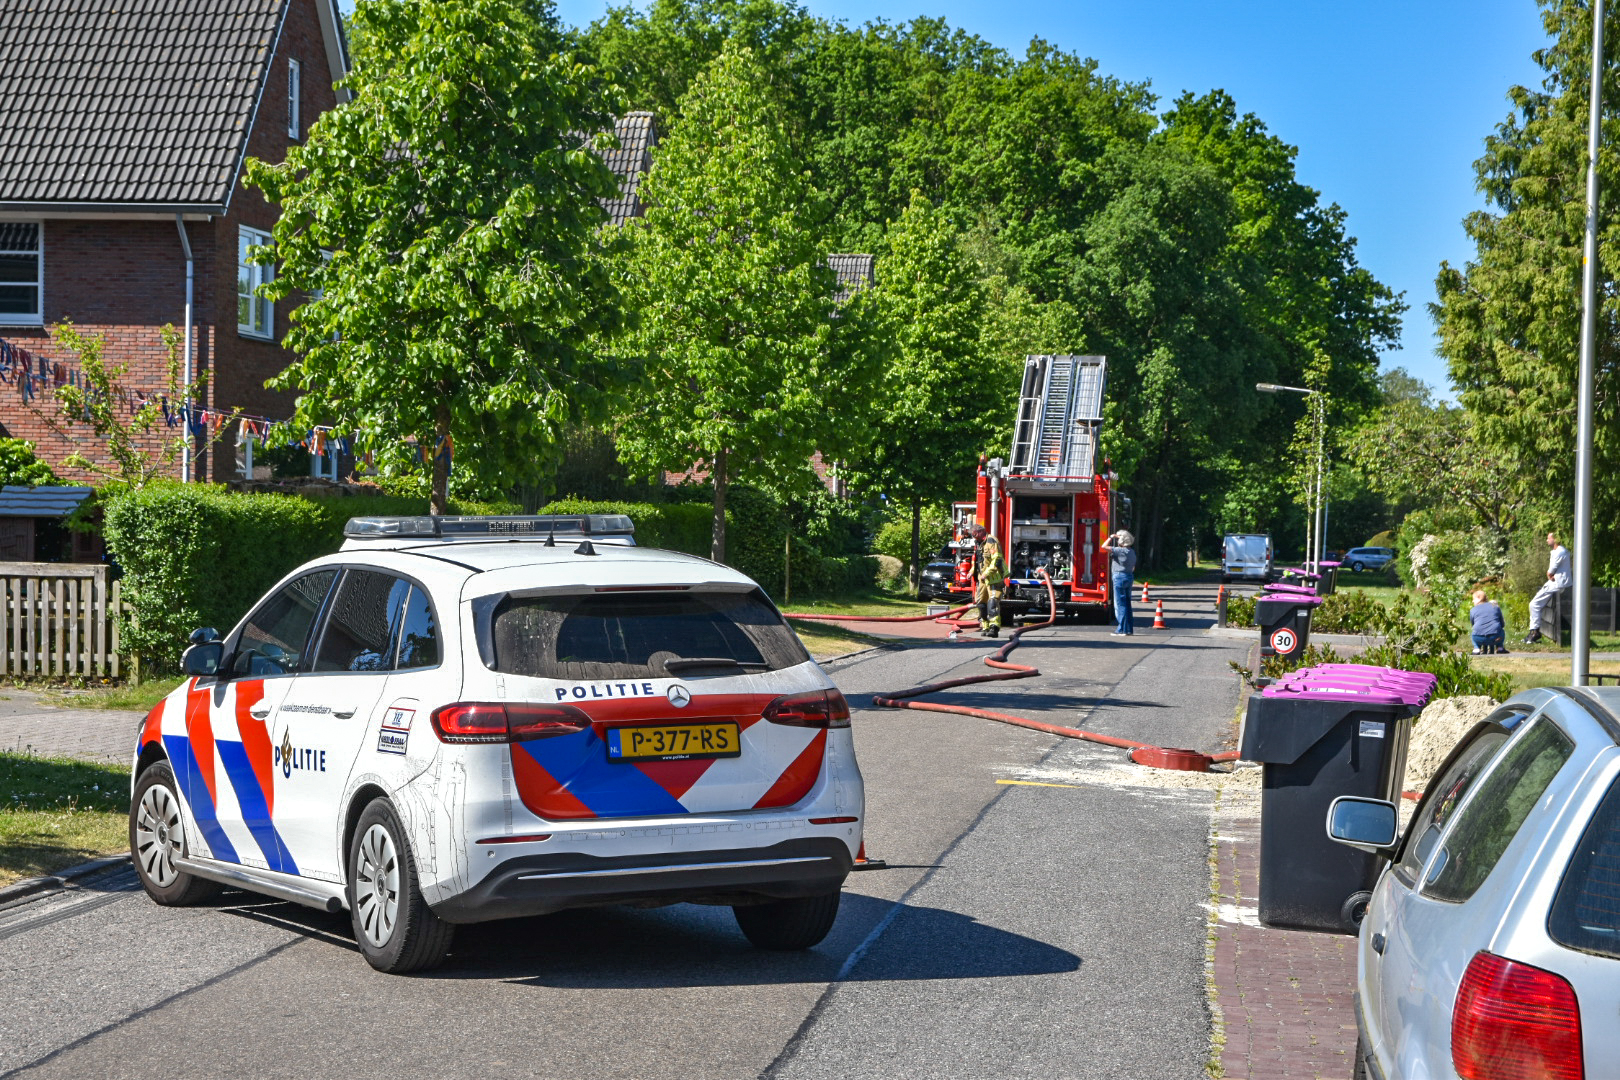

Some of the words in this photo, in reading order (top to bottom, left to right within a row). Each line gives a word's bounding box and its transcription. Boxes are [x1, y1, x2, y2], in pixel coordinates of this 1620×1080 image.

[1276, 635, 1291, 647] 30
[555, 682, 654, 701] POLITIE
[610, 746, 619, 754] NL
[632, 728, 729, 753] P-377-RS
[274, 745, 326, 779] POLITIE
